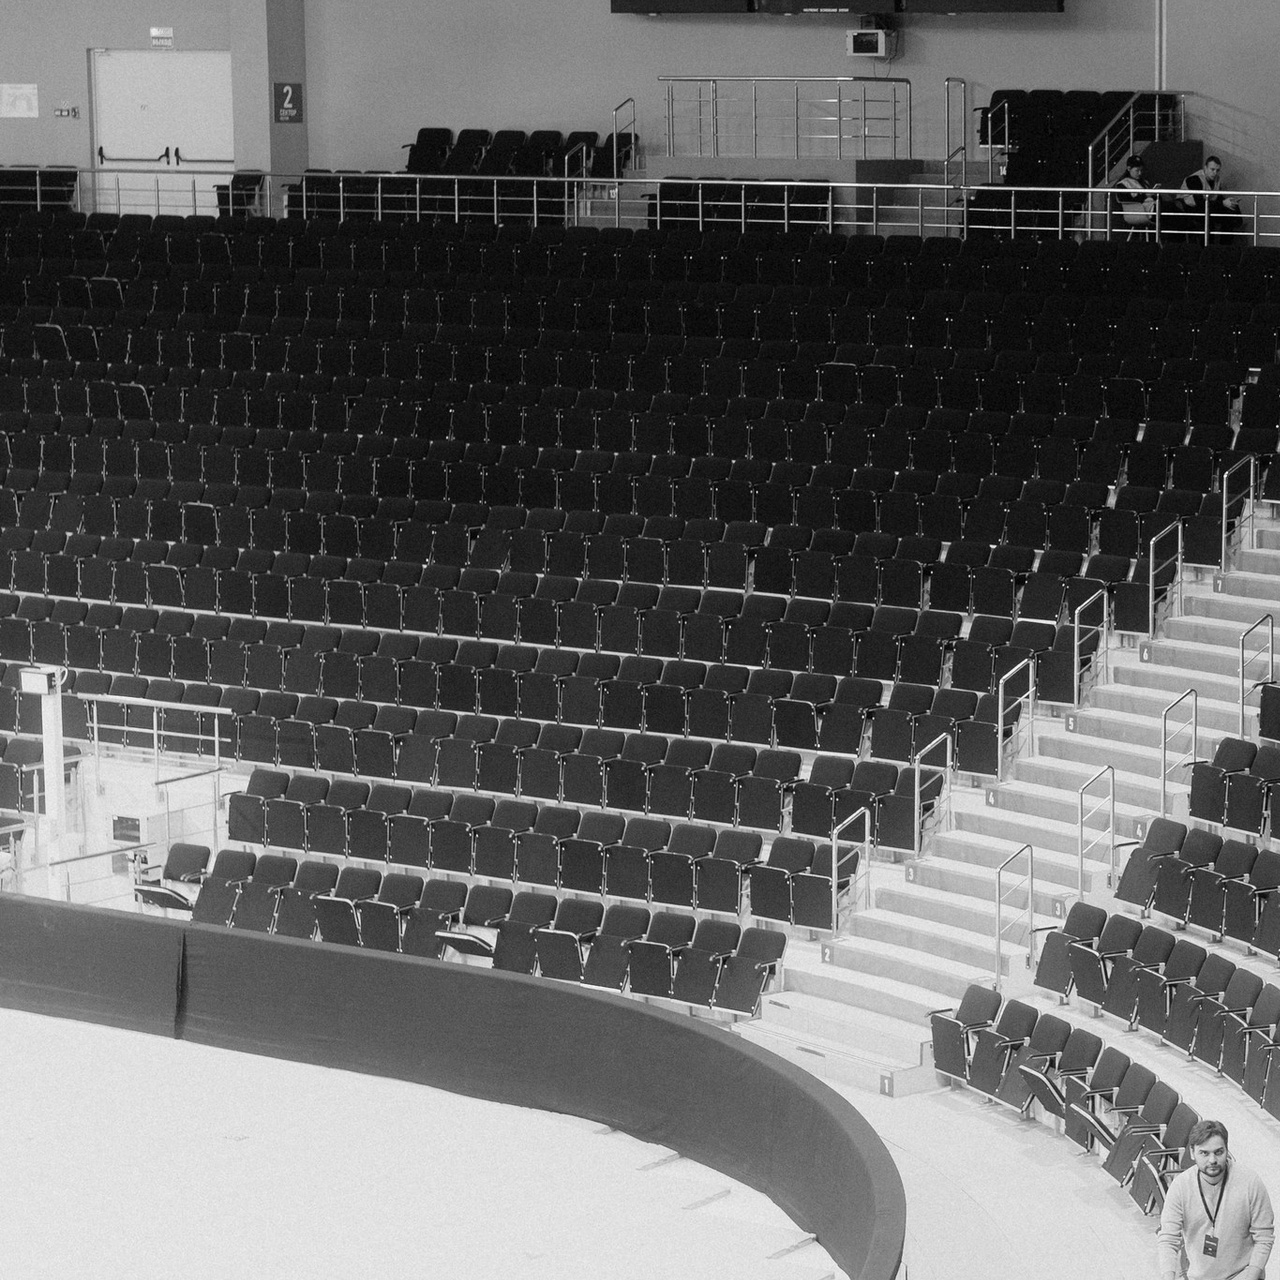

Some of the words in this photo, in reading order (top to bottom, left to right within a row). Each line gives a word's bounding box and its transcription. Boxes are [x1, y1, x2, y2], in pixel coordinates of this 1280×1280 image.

[283, 85, 293, 108] 2
[1143, 649, 1149, 661] 6
[1068, 717, 1074, 730] 5
[988, 791, 995, 805] 4
[1136, 823, 1143, 837] 4
[908, 867, 914, 881] 3
[1055, 902, 1061, 916] 3
[824, 948, 830, 962] 2
